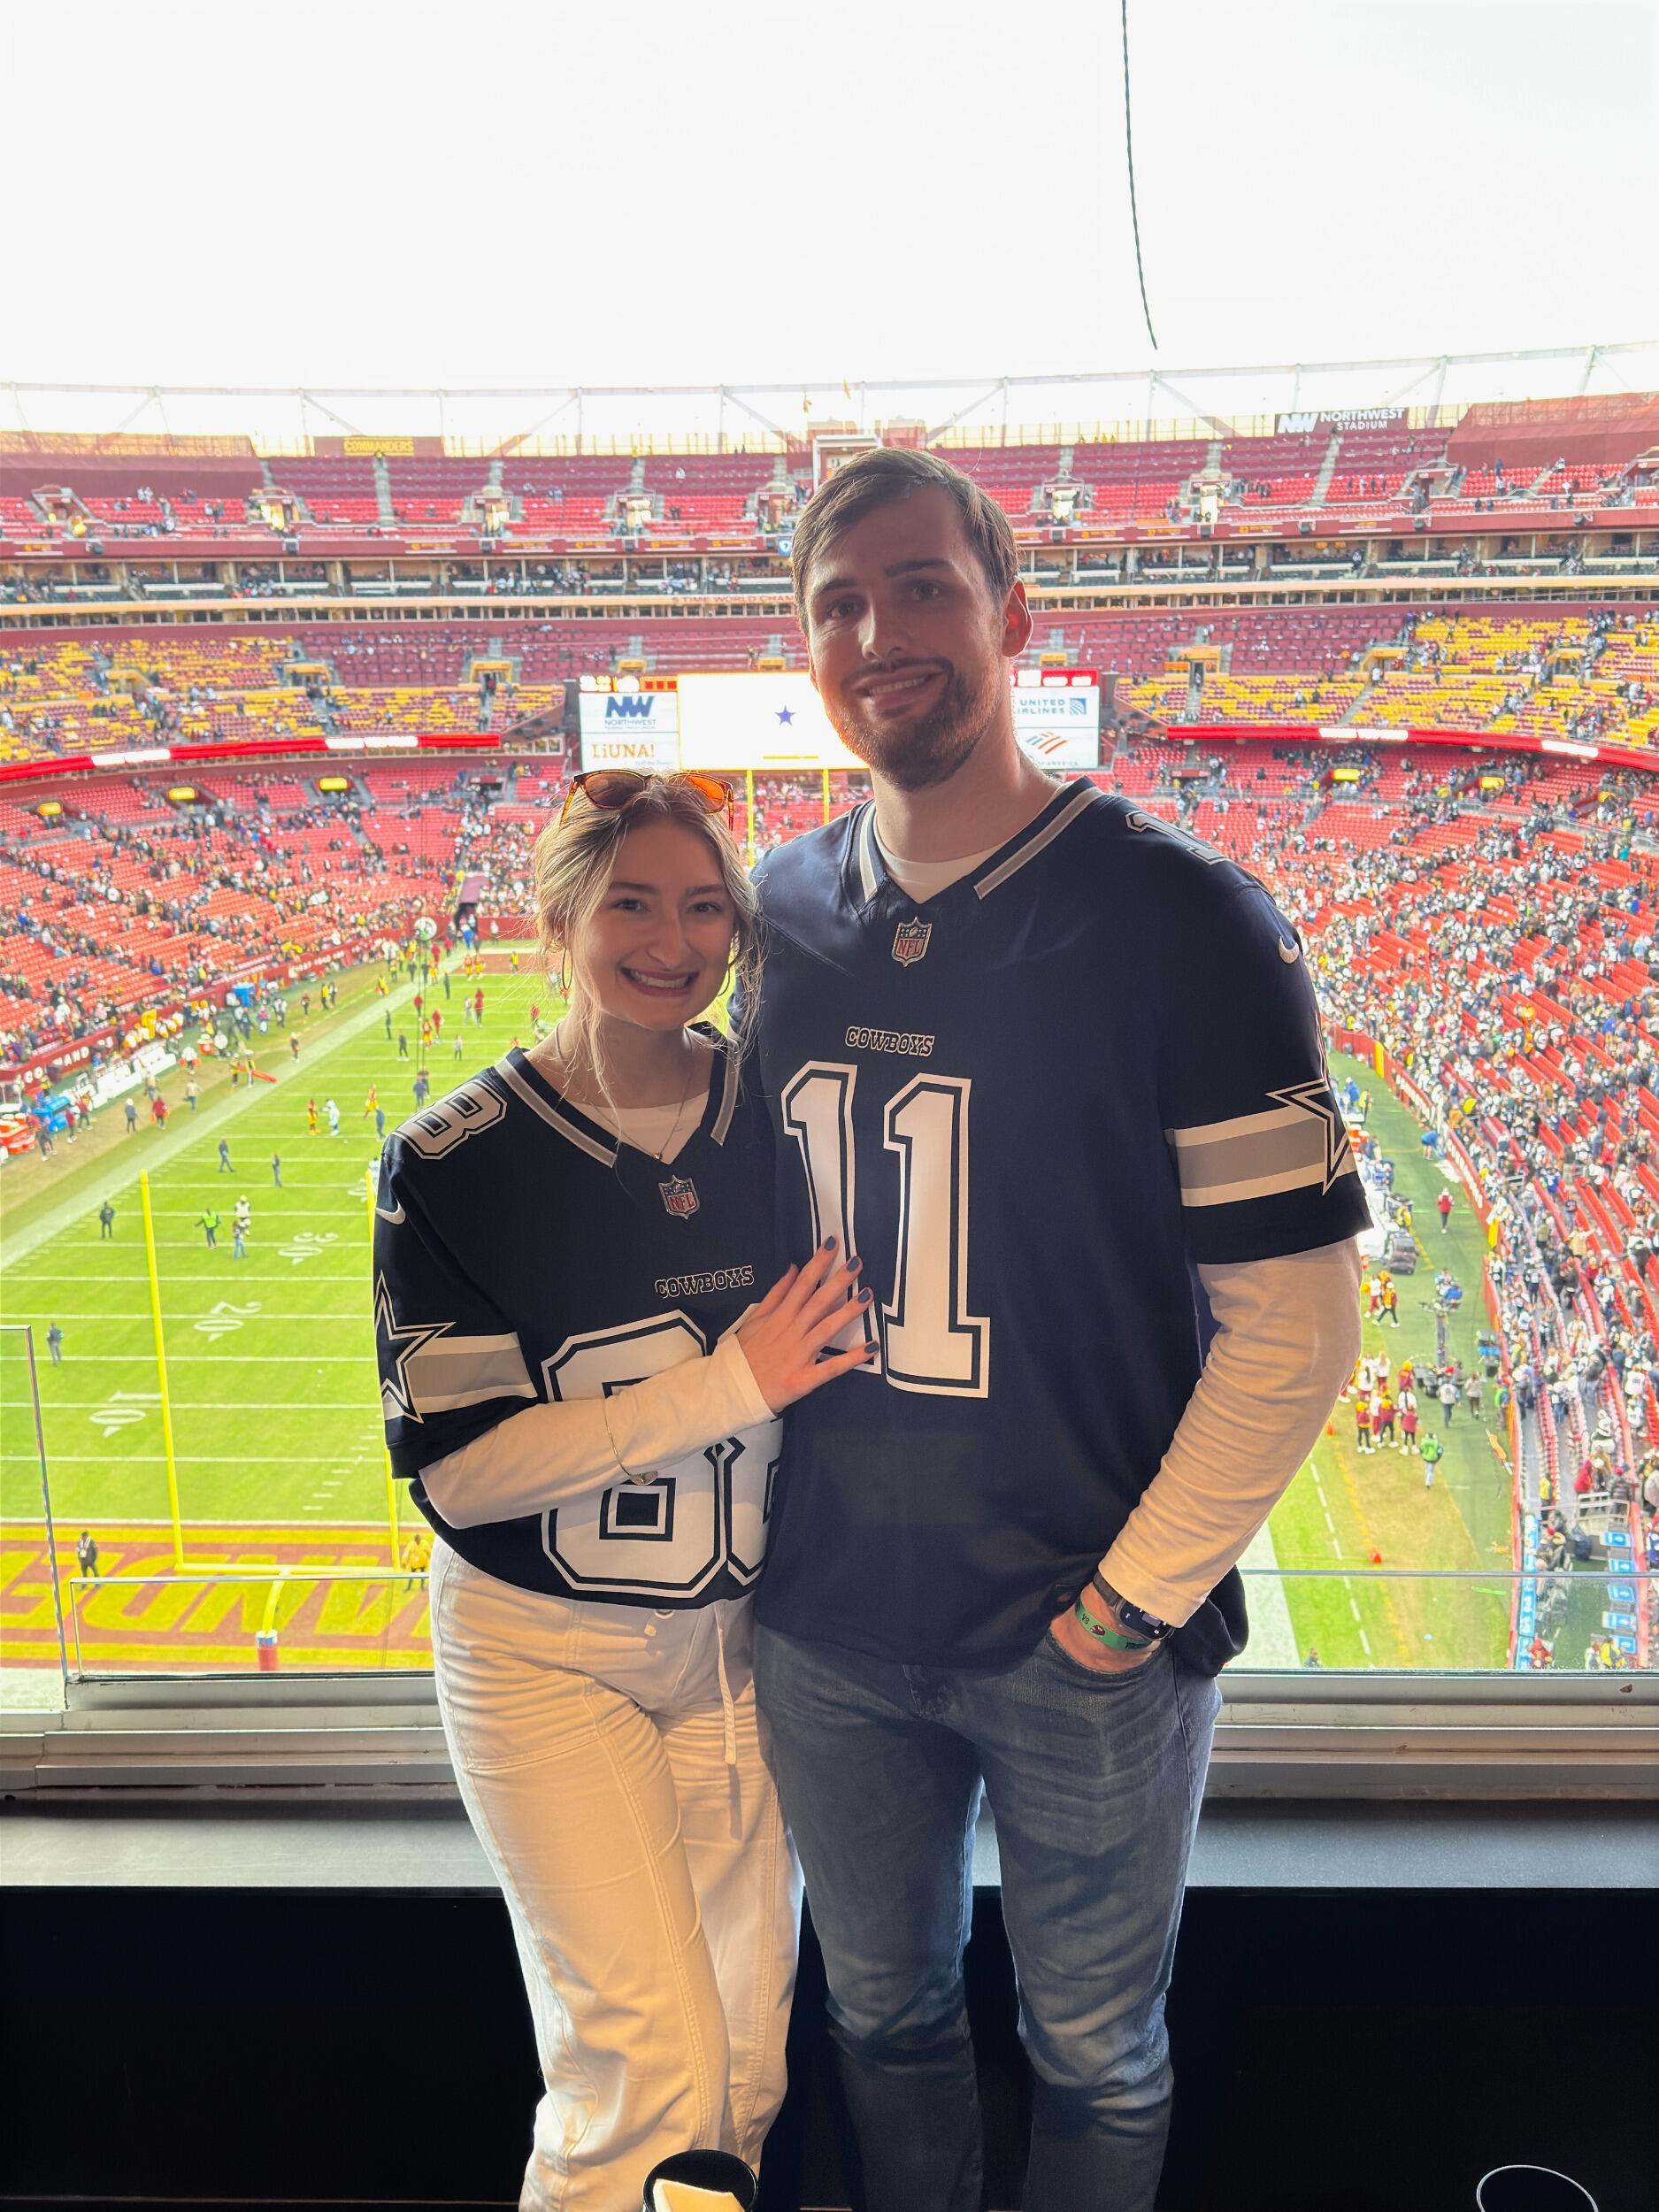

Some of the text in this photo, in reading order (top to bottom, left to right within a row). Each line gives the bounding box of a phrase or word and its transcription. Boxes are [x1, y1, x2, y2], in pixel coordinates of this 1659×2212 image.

[1319, 408, 1405, 423] NORTHWEST
[1337, 420, 1387, 431] STADIUM
[605, 695, 655, 718] NW
[592, 743, 655, 758] LiUNA!
[845, 1025, 935, 1056] COWBOYS
[392, 1079, 508, 1160] 8
[780, 1060, 990, 1398] 11
[654, 1265, 755, 1299] COWBOYS
